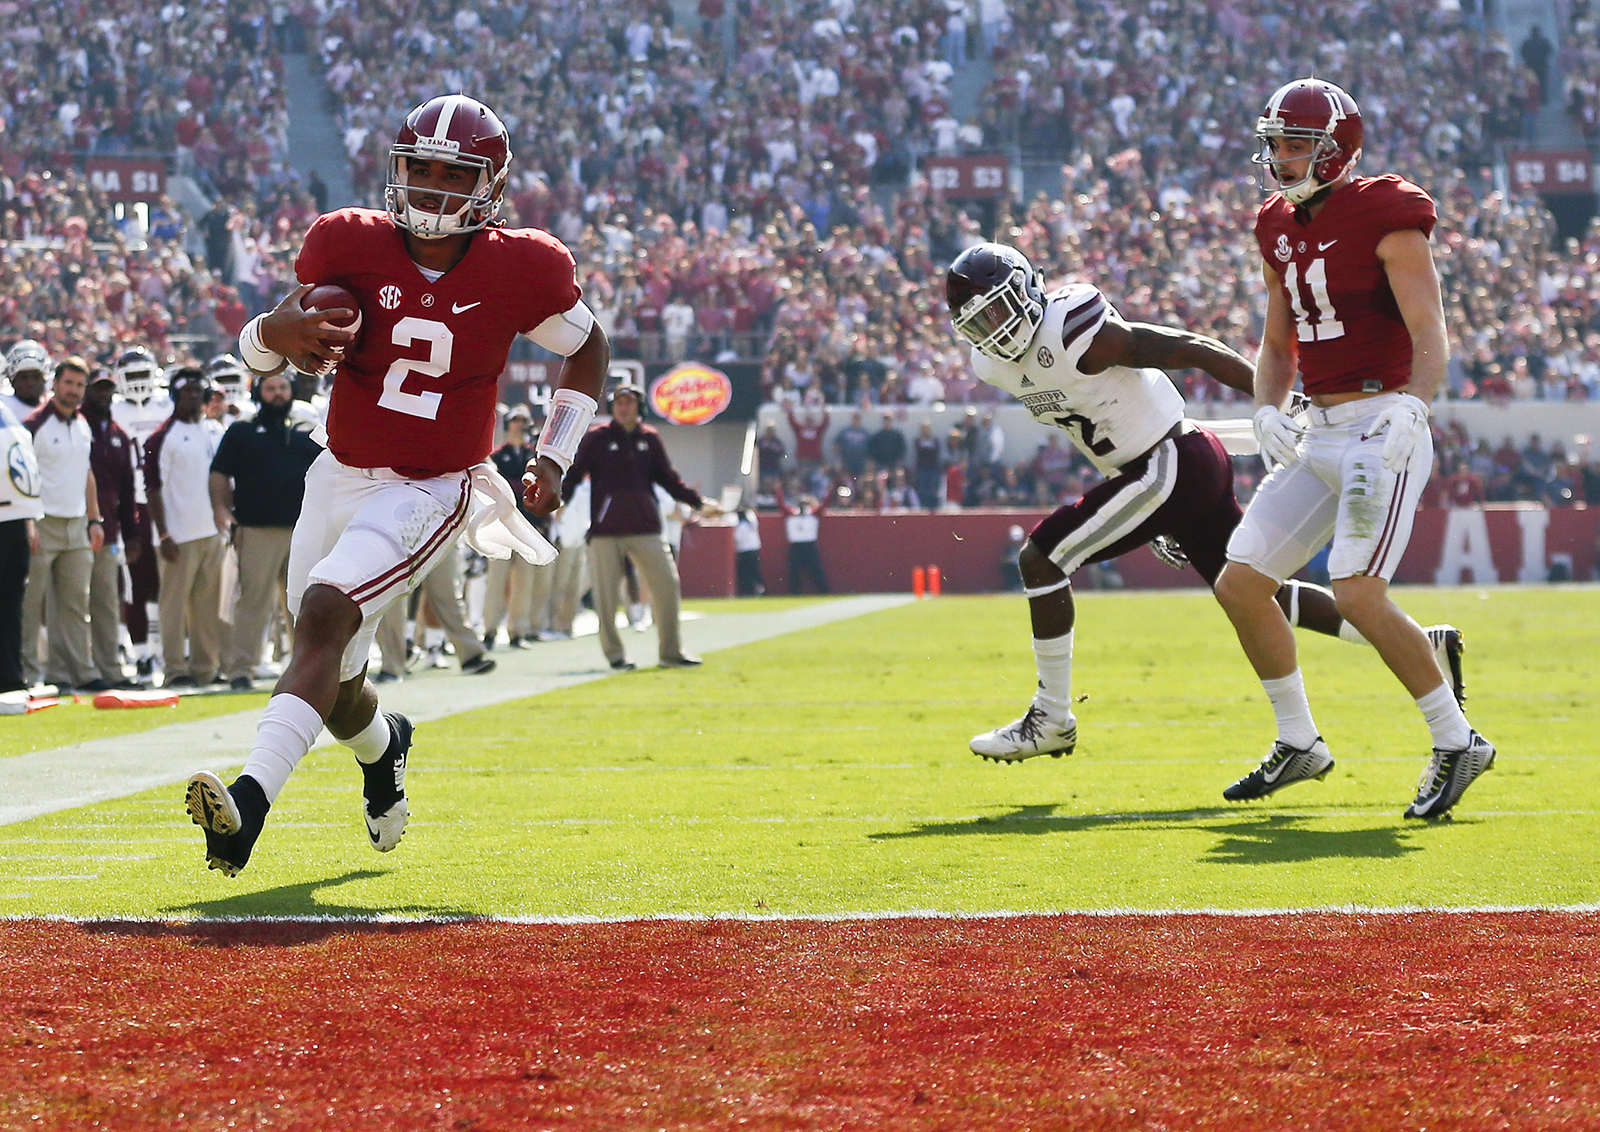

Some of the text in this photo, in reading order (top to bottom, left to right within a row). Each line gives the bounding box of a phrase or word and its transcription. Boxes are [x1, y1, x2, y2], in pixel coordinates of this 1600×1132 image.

[427, 138, 449, 148] BAMA
[379, 285, 402, 310] SEC
[1285, 258, 1345, 342] 11
[377, 316, 454, 420] 2
